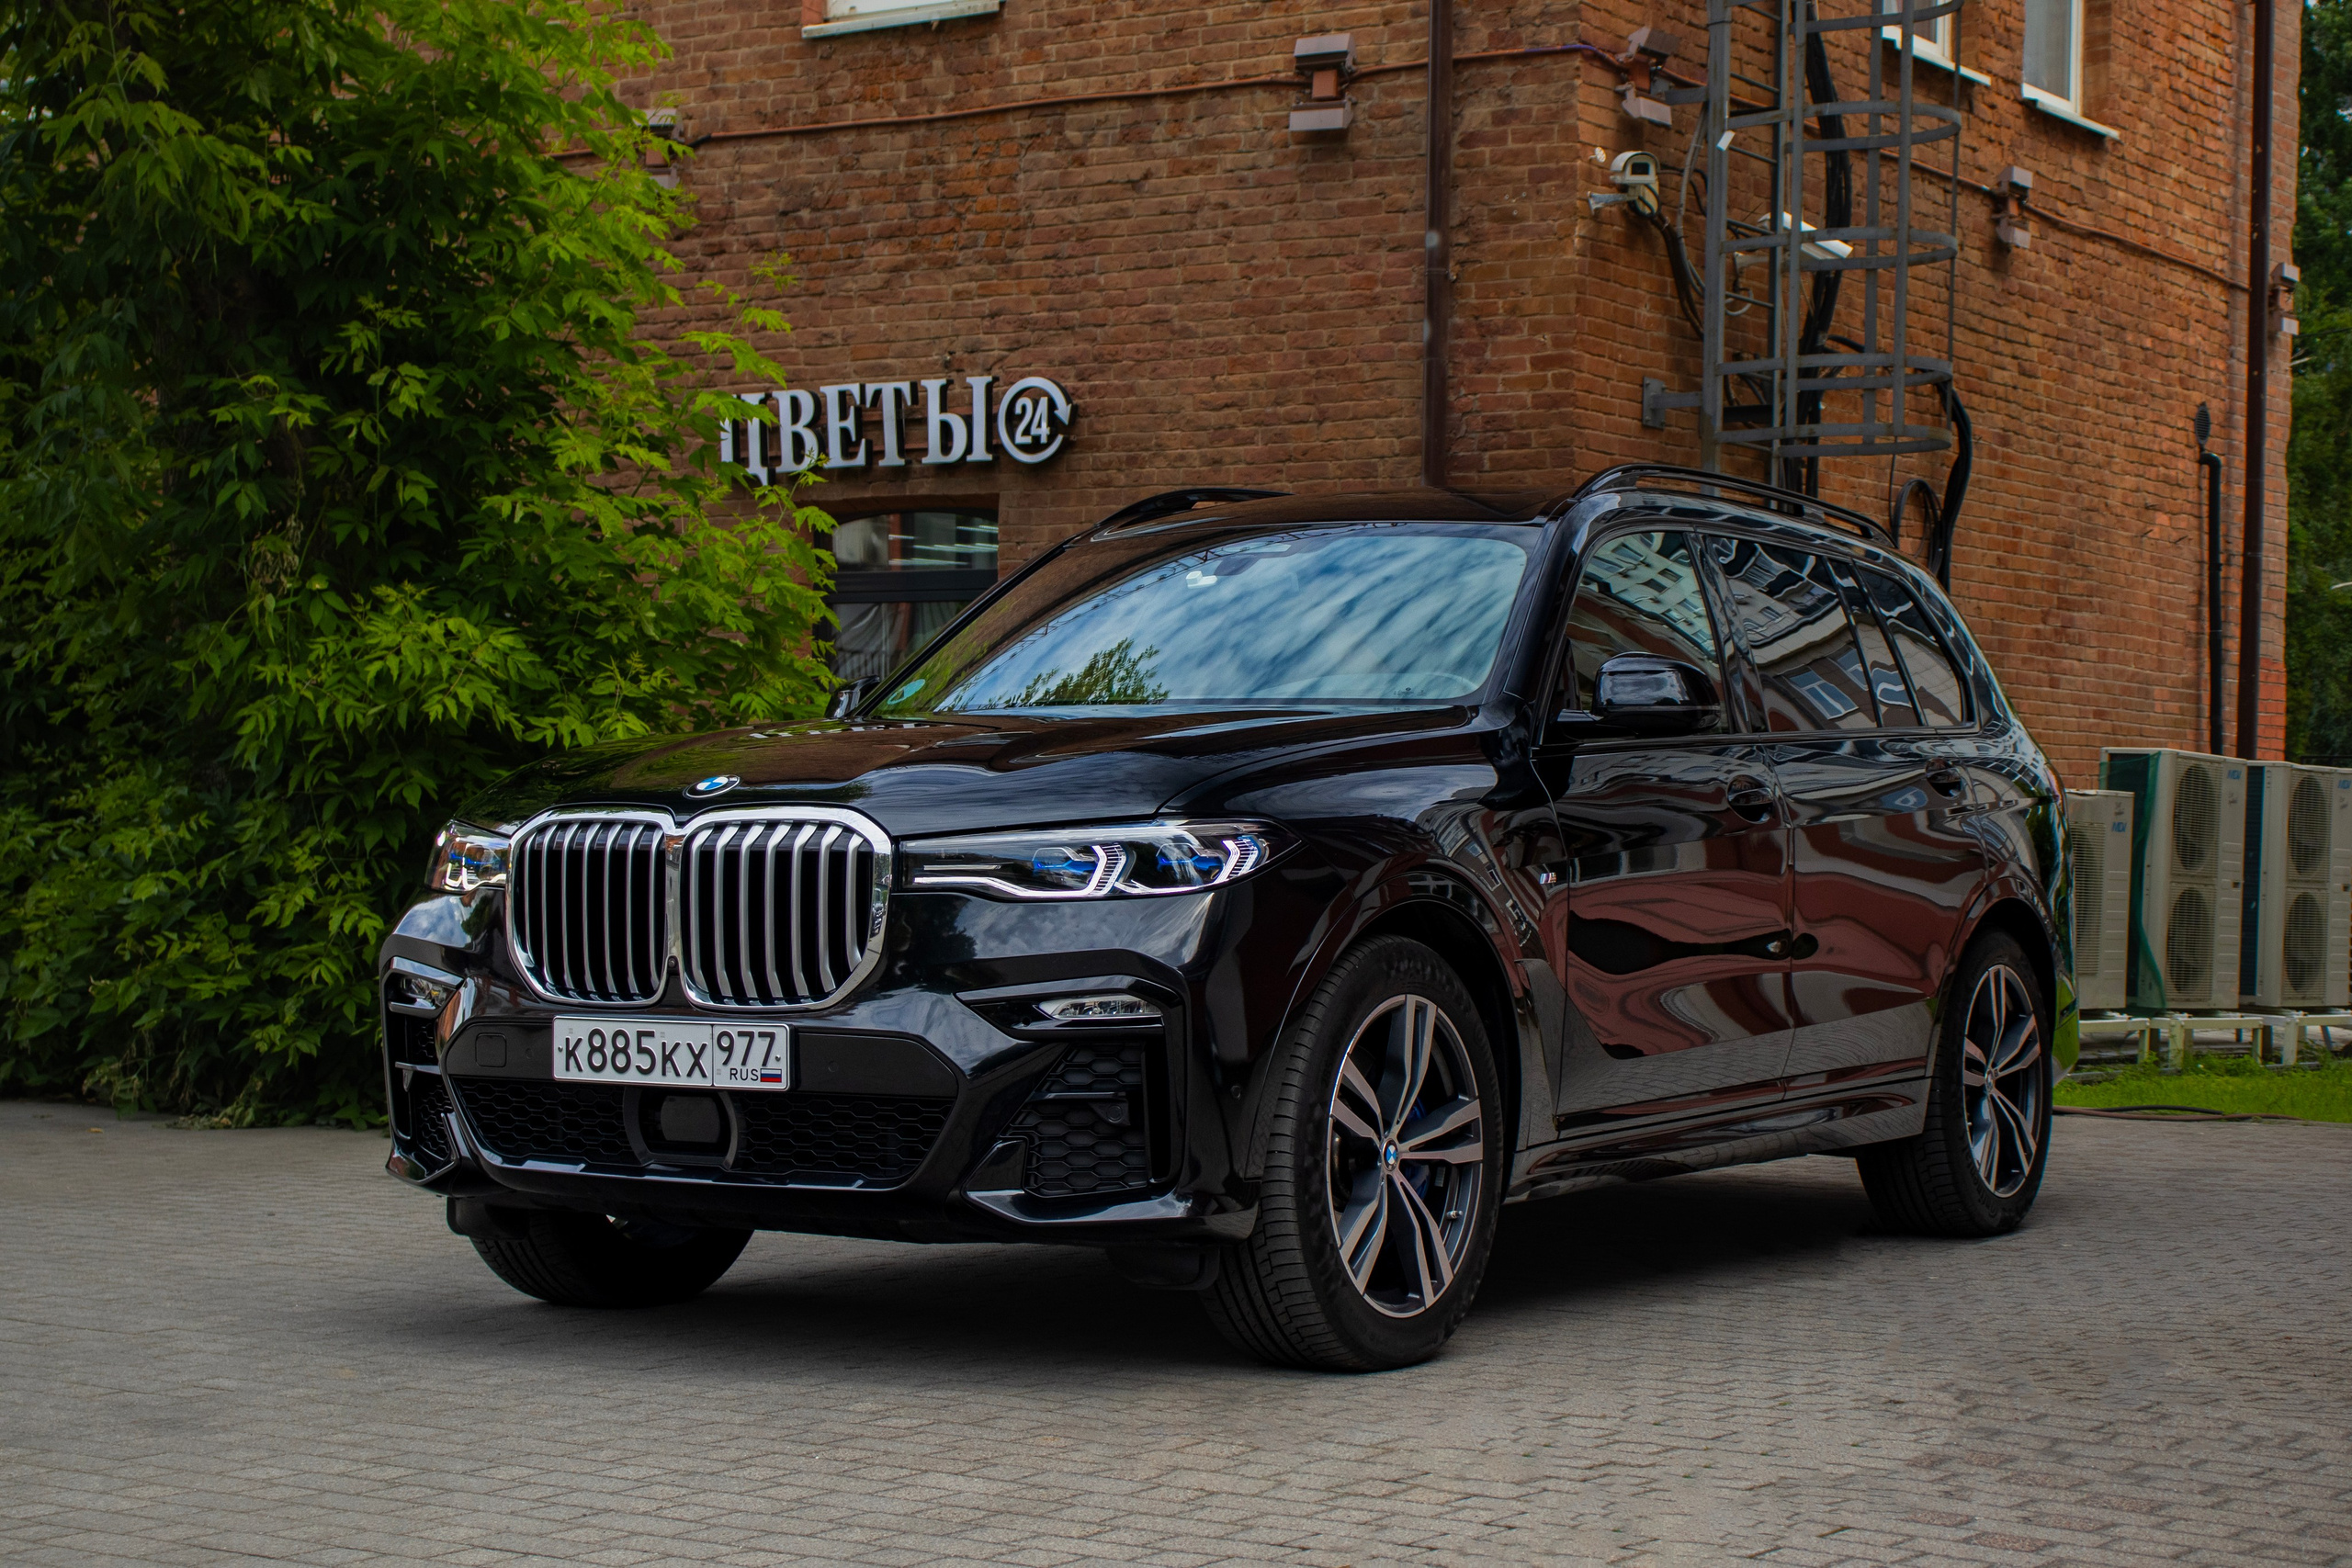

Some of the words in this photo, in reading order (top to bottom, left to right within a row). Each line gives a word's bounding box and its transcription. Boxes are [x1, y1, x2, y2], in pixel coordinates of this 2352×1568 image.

[1013, 396, 1050, 446] 24
[716, 1029, 776, 1066] 977
[729, 1067, 759, 1081] RUS
